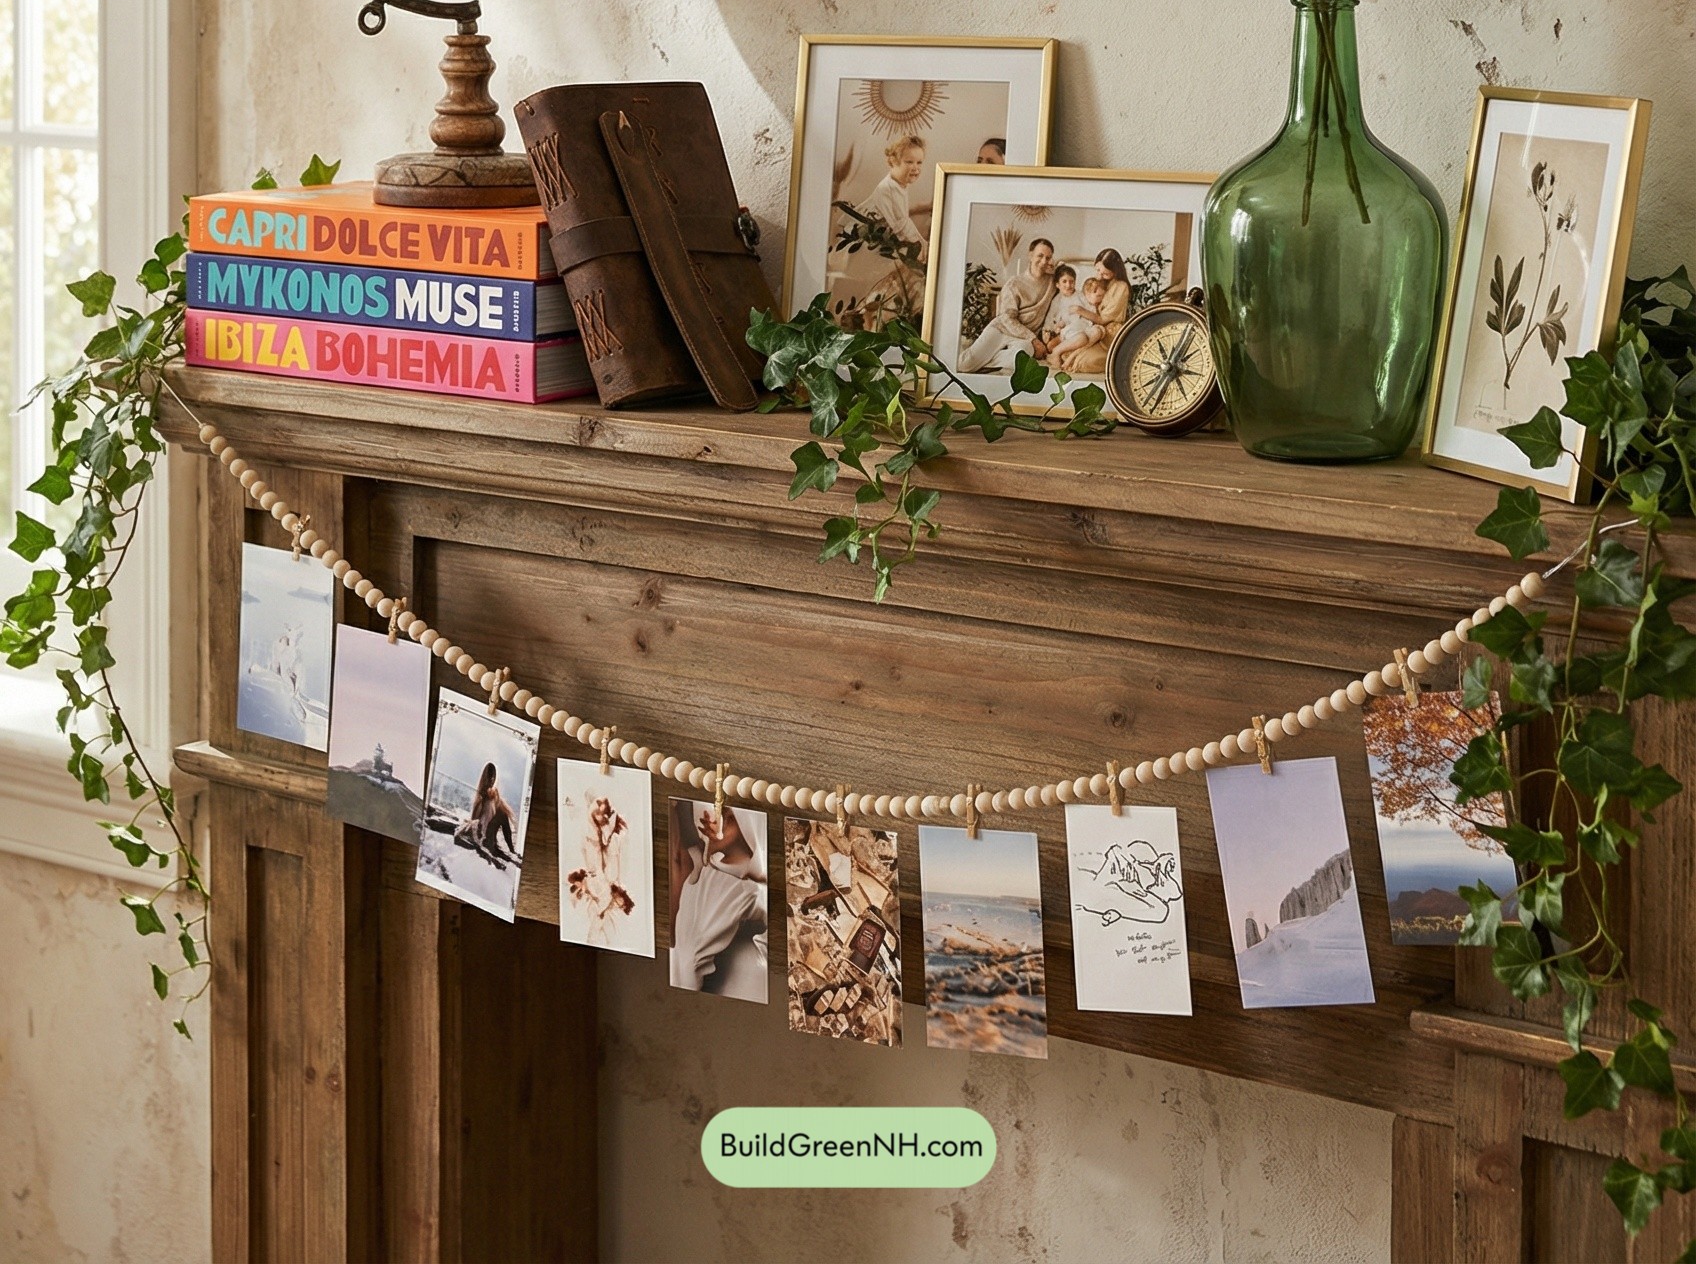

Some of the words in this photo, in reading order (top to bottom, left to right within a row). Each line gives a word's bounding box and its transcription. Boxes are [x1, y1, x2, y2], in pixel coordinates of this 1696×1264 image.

[208, 208, 308, 250] CAPRI
[313, 217, 420, 259] DOLCE
[427, 223, 511, 268] VITA
[207, 261, 389, 316] MYKONOS
[394, 277, 503, 330] MUSE
[205, 318, 310, 371] IBIZA
[315, 329, 507, 392] BOHEMIA
